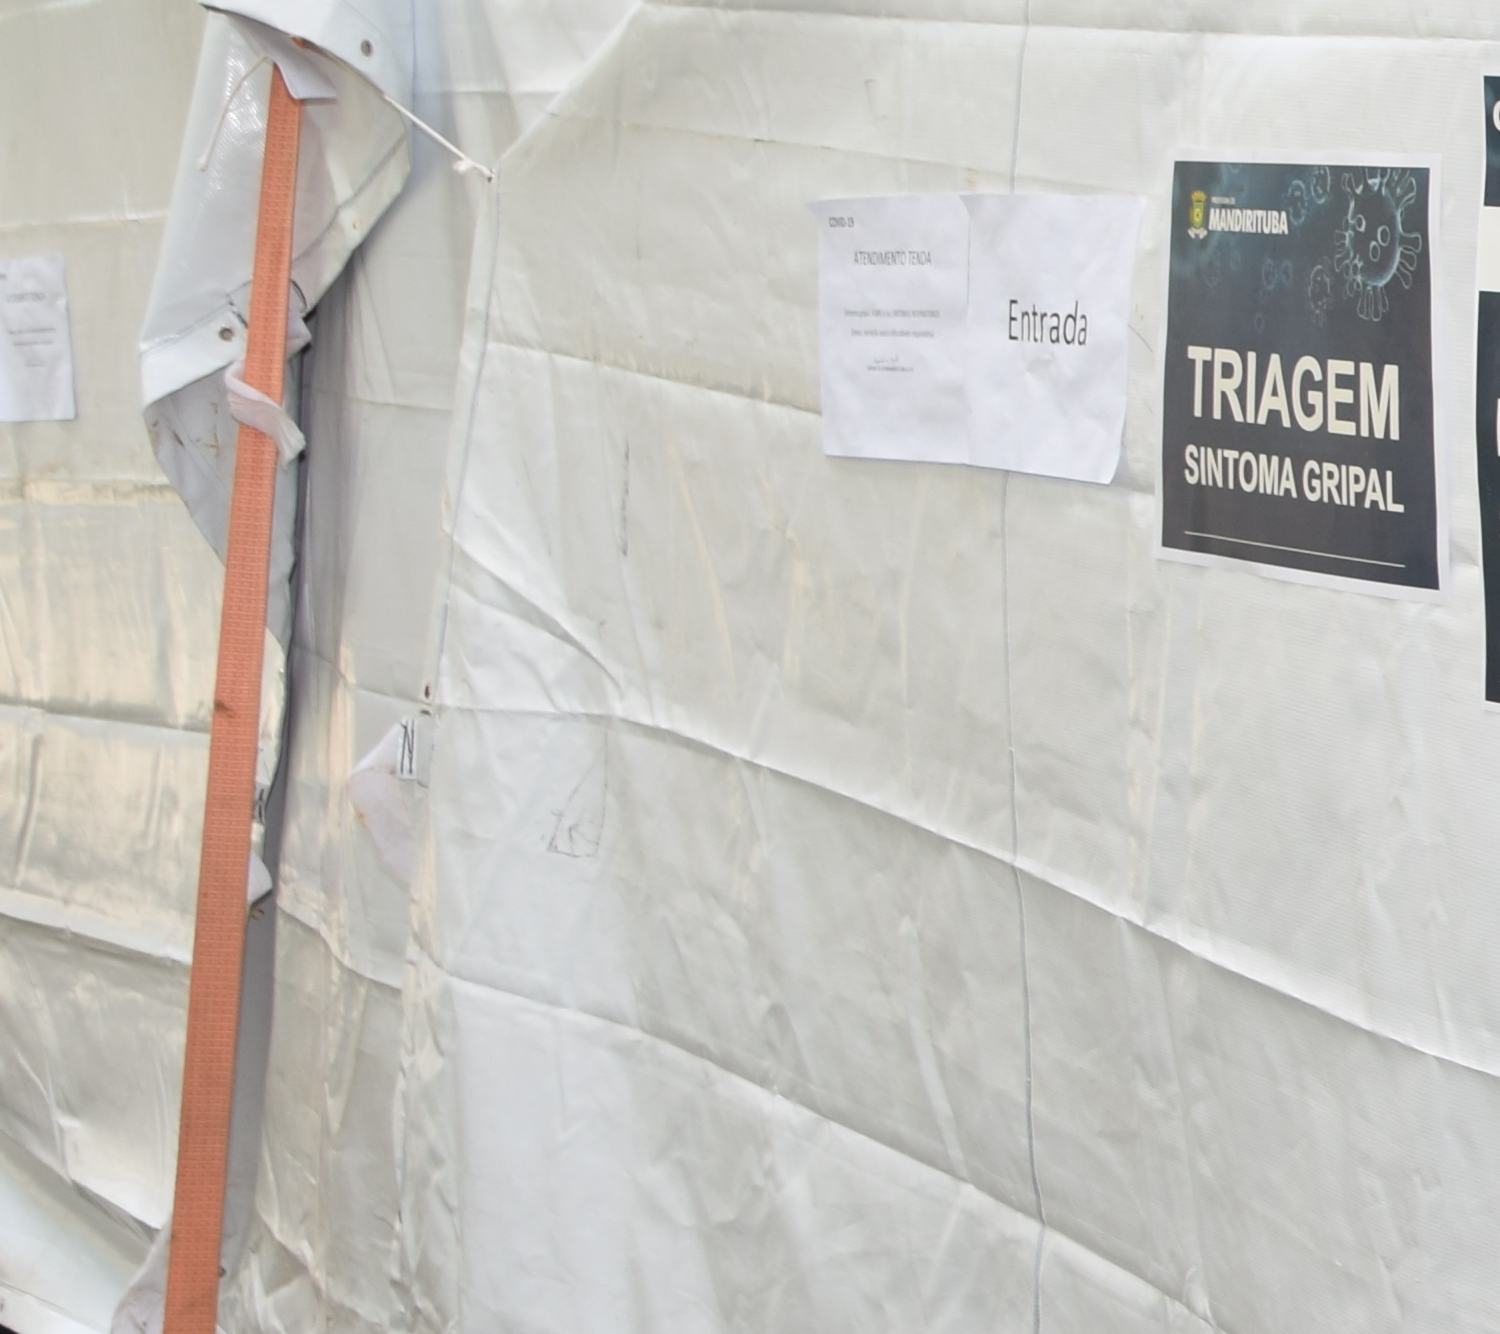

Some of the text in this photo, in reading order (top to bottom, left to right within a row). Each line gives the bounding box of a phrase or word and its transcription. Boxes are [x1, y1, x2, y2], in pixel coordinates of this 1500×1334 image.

[1209, 208, 1288, 235] MANDIRITUBA
[1009, 299, 1088, 346] Entrada
[1187, 345, 1400, 441] TRIAGEM
[1184, 444, 1404, 513] SINTOMA GRIPAL
